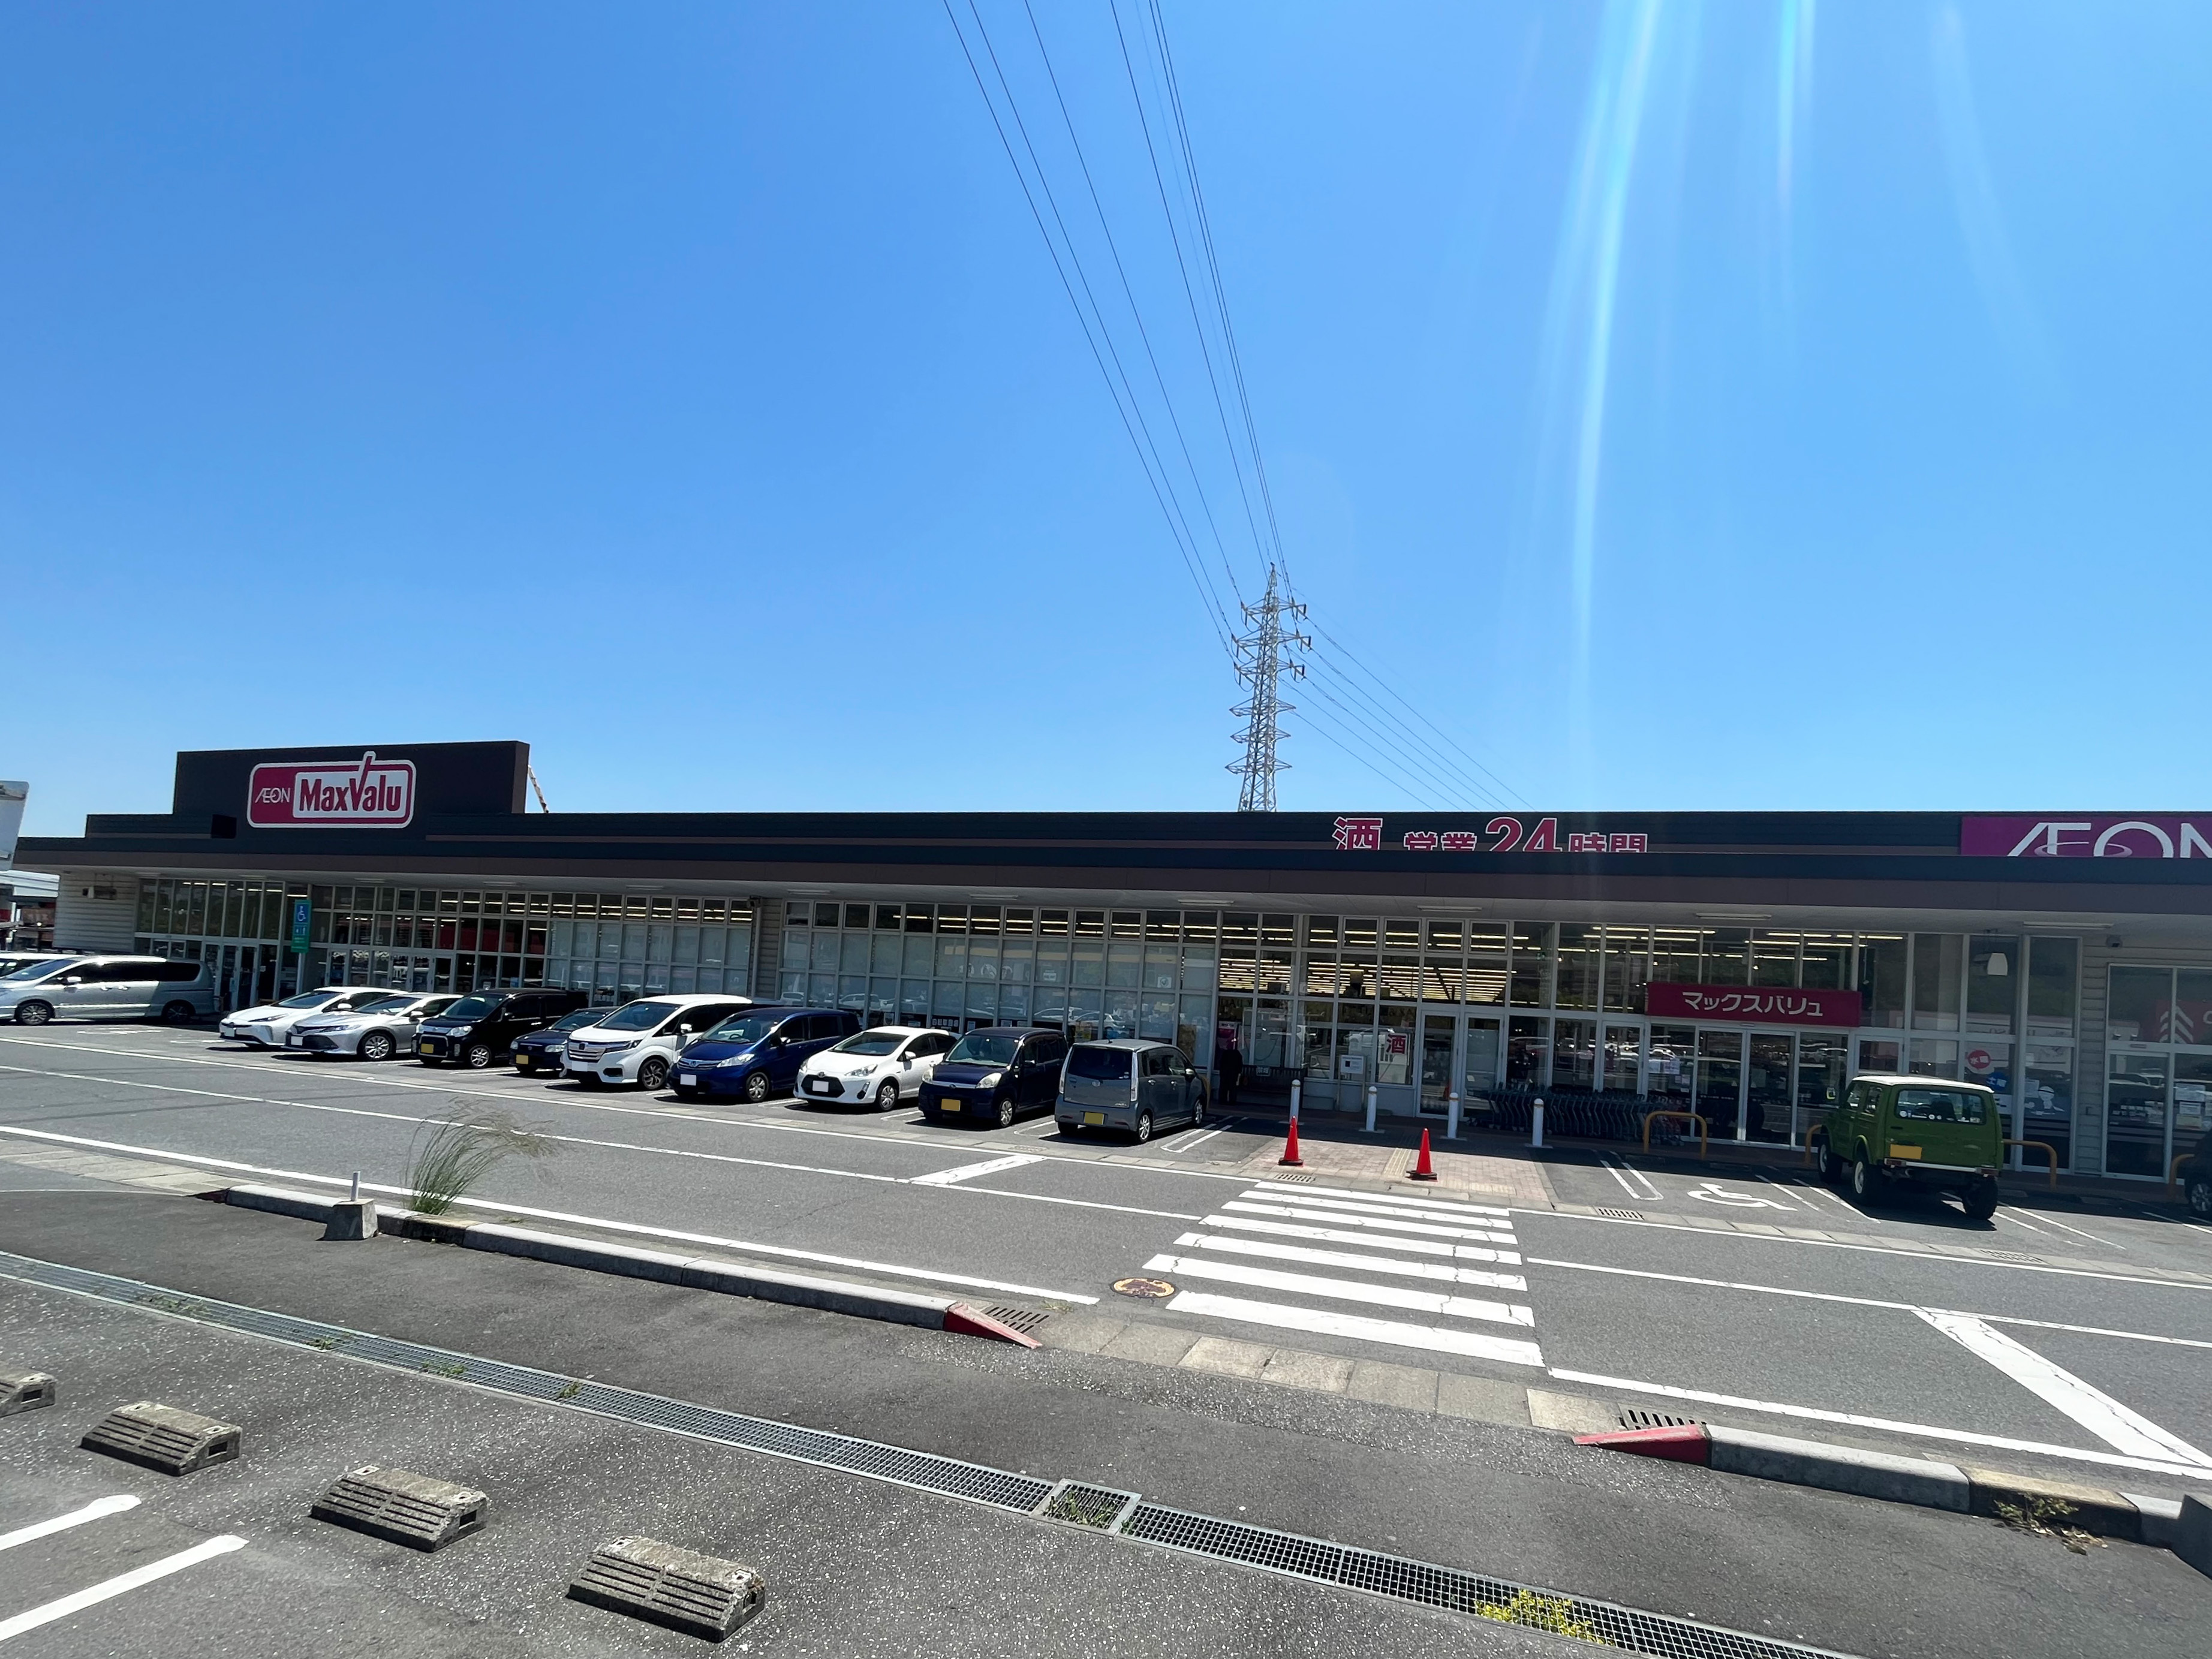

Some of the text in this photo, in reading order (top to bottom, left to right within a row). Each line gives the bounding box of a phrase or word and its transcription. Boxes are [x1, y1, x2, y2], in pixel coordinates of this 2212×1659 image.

[299, 756, 402, 812] MaxValu
[1682, 991, 1823, 1017] マックスバリュ
[1386, 1034, 1407, 1055] 酒
